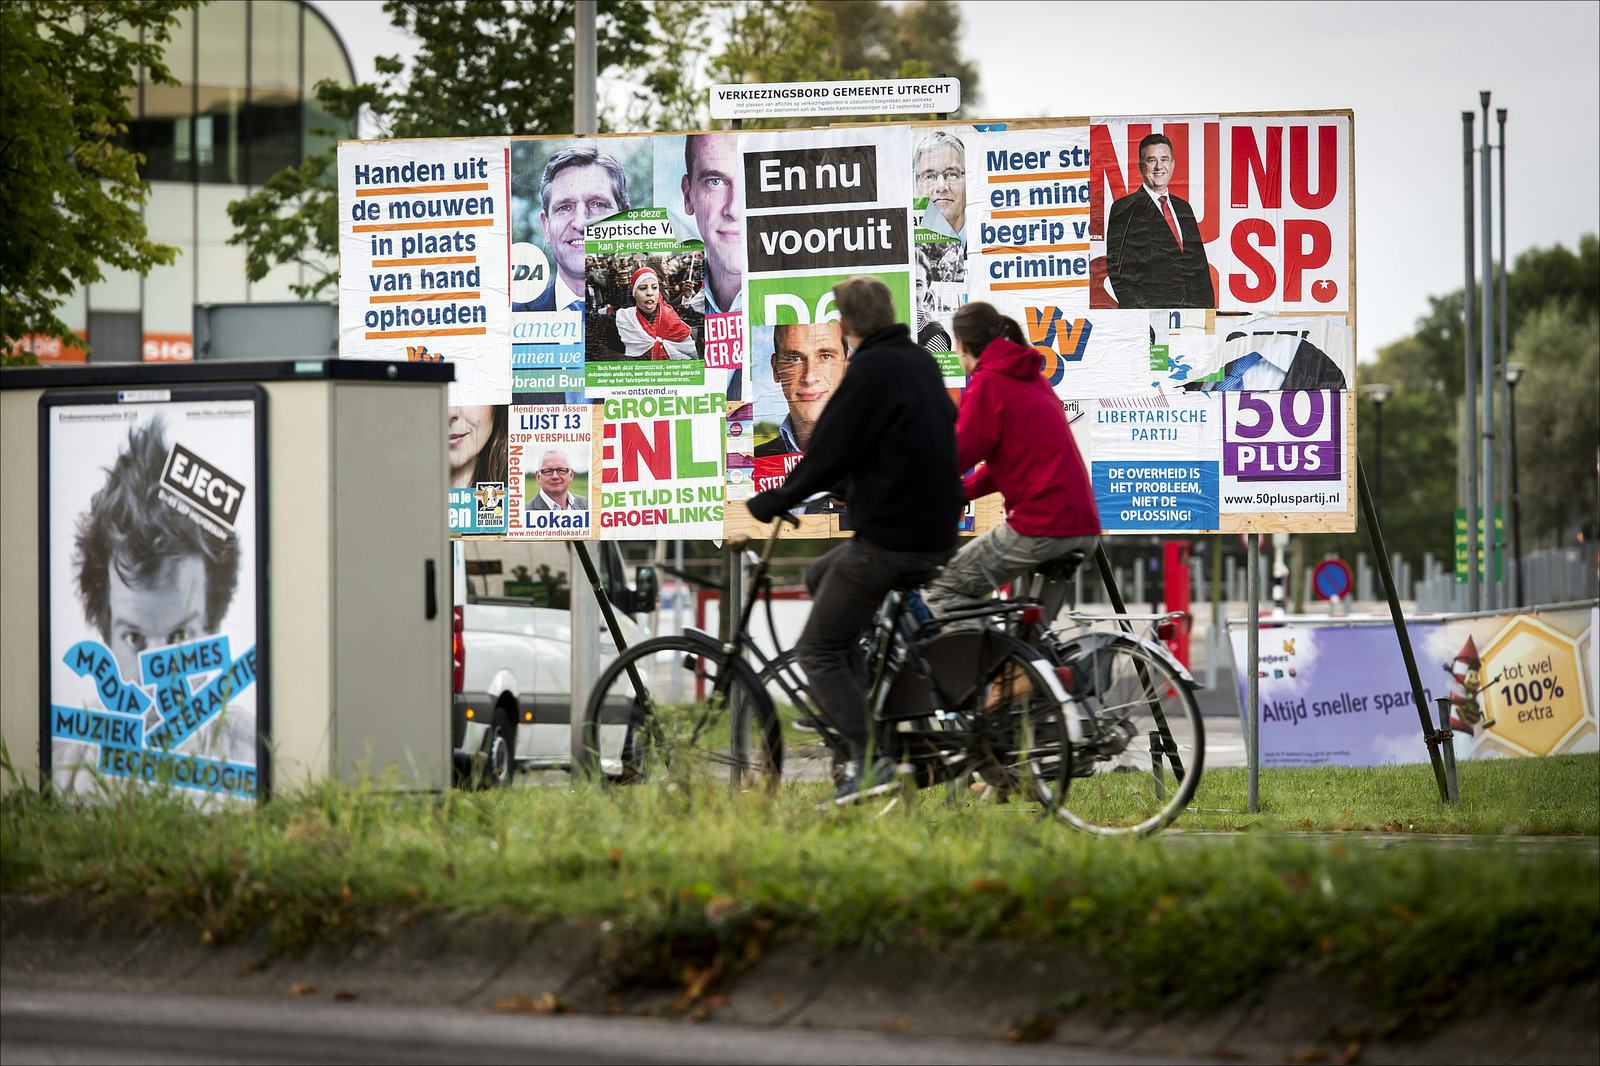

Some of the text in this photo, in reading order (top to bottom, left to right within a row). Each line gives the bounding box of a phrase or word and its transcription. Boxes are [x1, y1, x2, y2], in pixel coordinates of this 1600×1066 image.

[718, 84, 951, 100] VERKIEZINGSBORD GEMEENTE UTRECHT
[355, 157, 488, 185] Handen uit
[987, 149, 1050, 172] Meer
[1231, 125, 1337, 210] NU
[759, 159, 861, 193] En nu
[991, 182, 1090, 207] en mind
[352, 196, 494, 221] de mouwen
[627, 209, 661, 220] op deze
[586, 223, 657, 240] Egyptische
[760, 217, 892, 256] vooruit
[981, 219, 1090, 245] begrip v
[371, 231, 476, 258] in plaats
[598, 241, 613, 251] kan
[616, 241, 624, 252] je
[627, 241, 645, 249] niet
[512, 264, 543, 281] DA
[990, 253, 1090, 279] crimine
[369, 266, 480, 292] van hand
[365, 303, 487, 331] ophouden
[559, 351, 581, 363] we
[611, 387, 678, 396] www.ontstemd.org
[513, 405, 544, 413] Hendrie
[604, 392, 726, 420] GROENER
[1097, 409, 1207, 424] LIBERTARISCHE
[1234, 390, 1325, 439] 50
[521, 414, 581, 430] LIJST 13
[510, 433, 591, 443] STOP VERSPILLING
[1131, 428, 1178, 441] PARTIJ
[1238, 445, 1321, 472] PLUS
[170, 452, 241, 514] EJECT
[1108, 467, 1200, 479] DE OVERHEID IS
[460, 490, 471, 505] je
[509, 445, 523, 528] Nederland
[601, 486, 725, 509] DE TIJD IS NU
[1110, 481, 1202, 495] HET PROBLEEM,
[1224, 492, 1340, 505] www.50pluspartij.nl
[1132, 496, 1177, 508] NIET DE
[526, 511, 590, 529] Lokaal
[600, 505, 724, 528] GROENLINKS
[1120, 509, 1192, 521] OPLOSSING!
[509, 529, 590, 537] www.nederlandlokaal.nl
[149, 642, 223, 679] GAMES
[1503, 654, 1553, 680] tot wel
[76, 647, 141, 714] MEDIA
[1501, 675, 1564, 707] 100%
[159, 679, 187, 713] EN
[1263, 698, 1308, 726] Altijd
[1312, 692, 1369, 718] sneller
[1517, 704, 1554, 723] extra
[56, 711, 138, 746] MUZIEK
[100, 746, 257, 795] TECHOLOGIE
